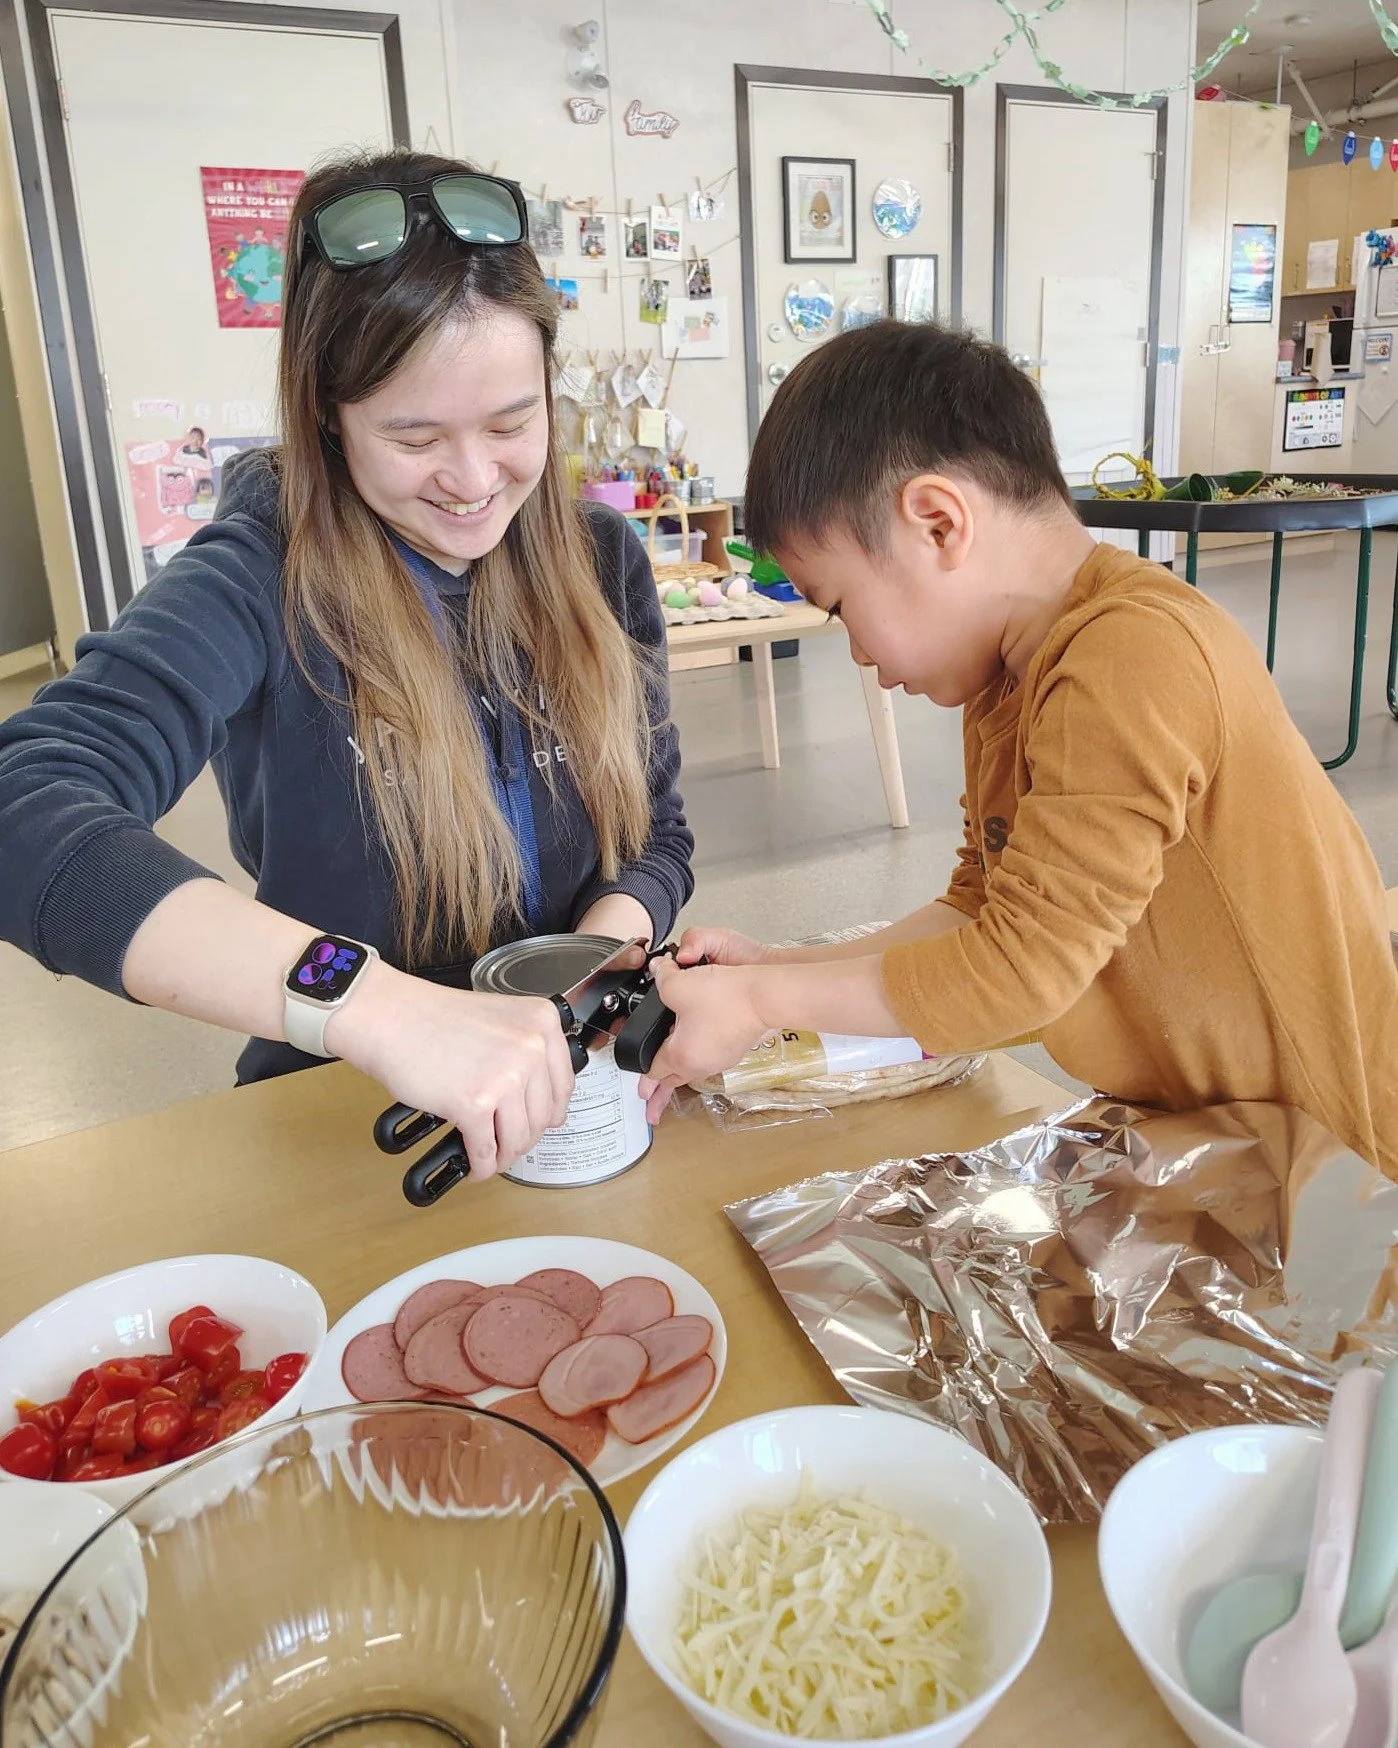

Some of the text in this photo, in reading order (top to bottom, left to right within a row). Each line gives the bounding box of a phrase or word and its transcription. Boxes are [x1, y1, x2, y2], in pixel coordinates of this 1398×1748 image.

[223, 181, 235, 192] IN
[236, 182, 245, 192] A
[206, 195, 243, 205] WHERE
[246, 196, 266, 206] YOU
[267, 197, 287, 207] CAN
[211, 207, 258, 218] ANYTHING
